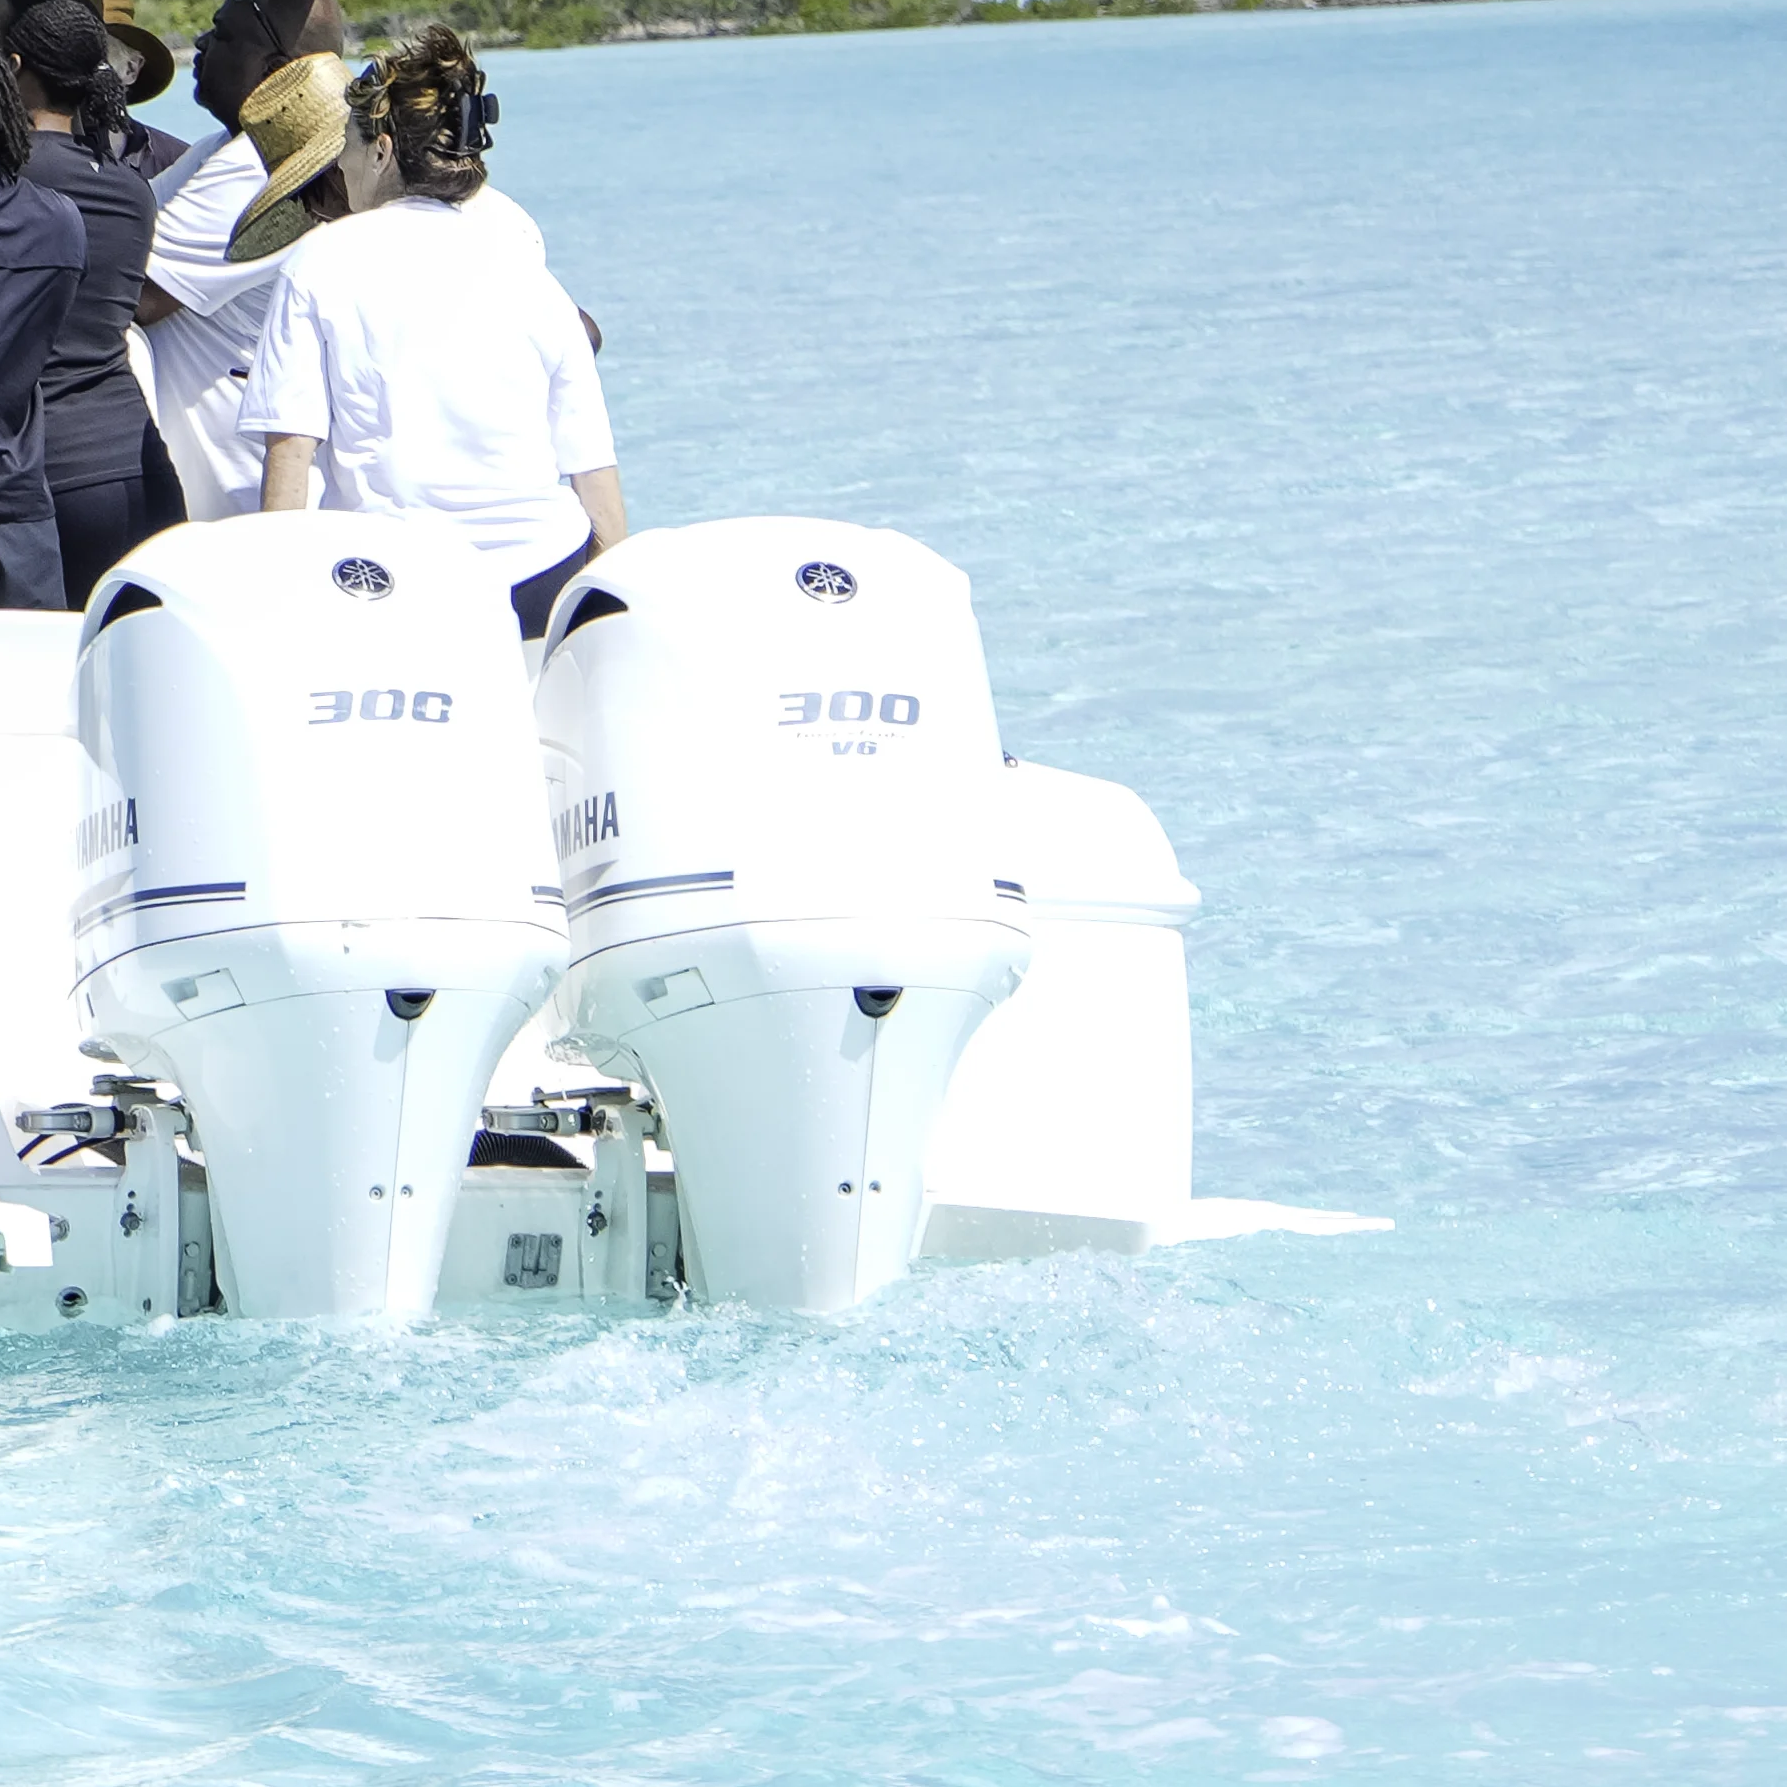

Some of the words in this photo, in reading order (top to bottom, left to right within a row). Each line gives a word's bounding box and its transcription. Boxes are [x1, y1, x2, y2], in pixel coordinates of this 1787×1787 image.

[308, 689, 453, 725] 300
[778, 690, 921, 726] 300
[831, 740, 878, 755] V6
